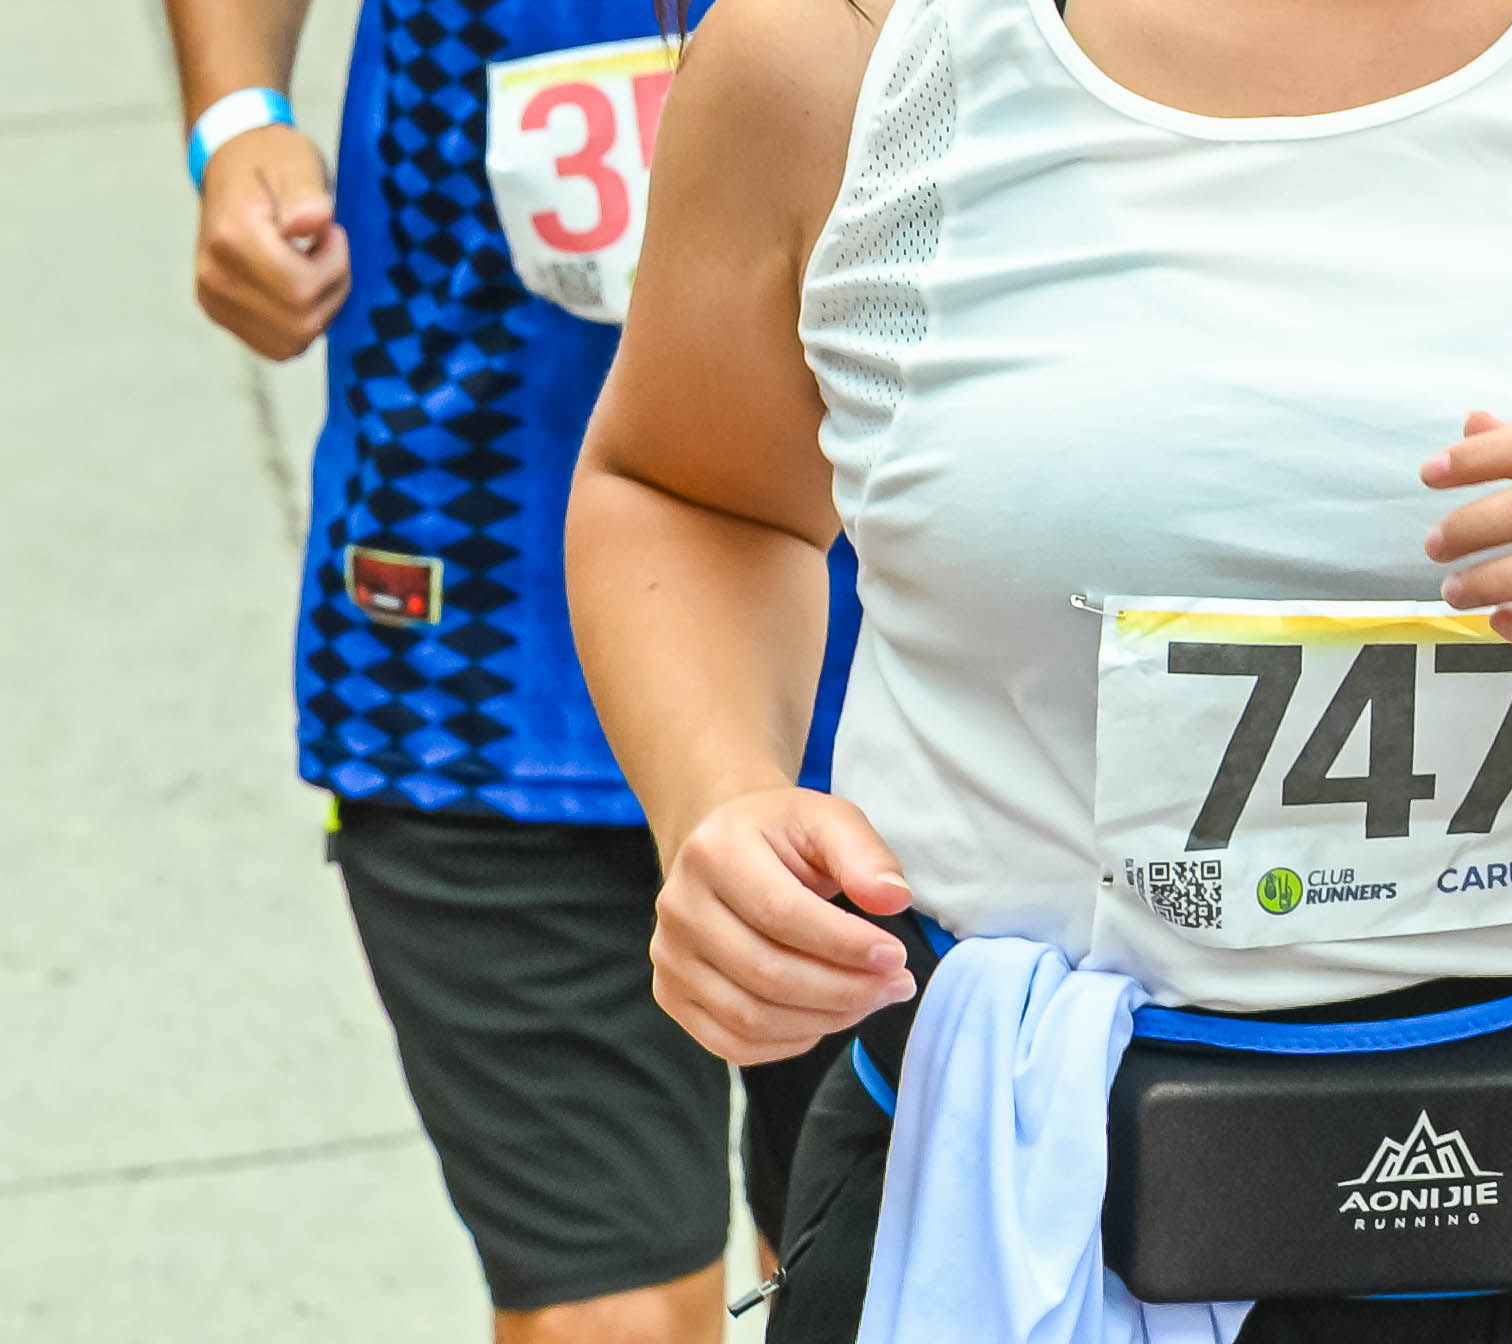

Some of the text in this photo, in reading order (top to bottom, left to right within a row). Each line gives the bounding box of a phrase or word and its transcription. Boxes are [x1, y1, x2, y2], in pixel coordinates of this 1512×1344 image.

[1307, 868, 1355, 885] CLUB
[1306, 881, 1397, 905] RUNNER'S
[1339, 1181, 1498, 1213] AONIJIE
[1354, 1212, 1480, 1231] RUNNING
